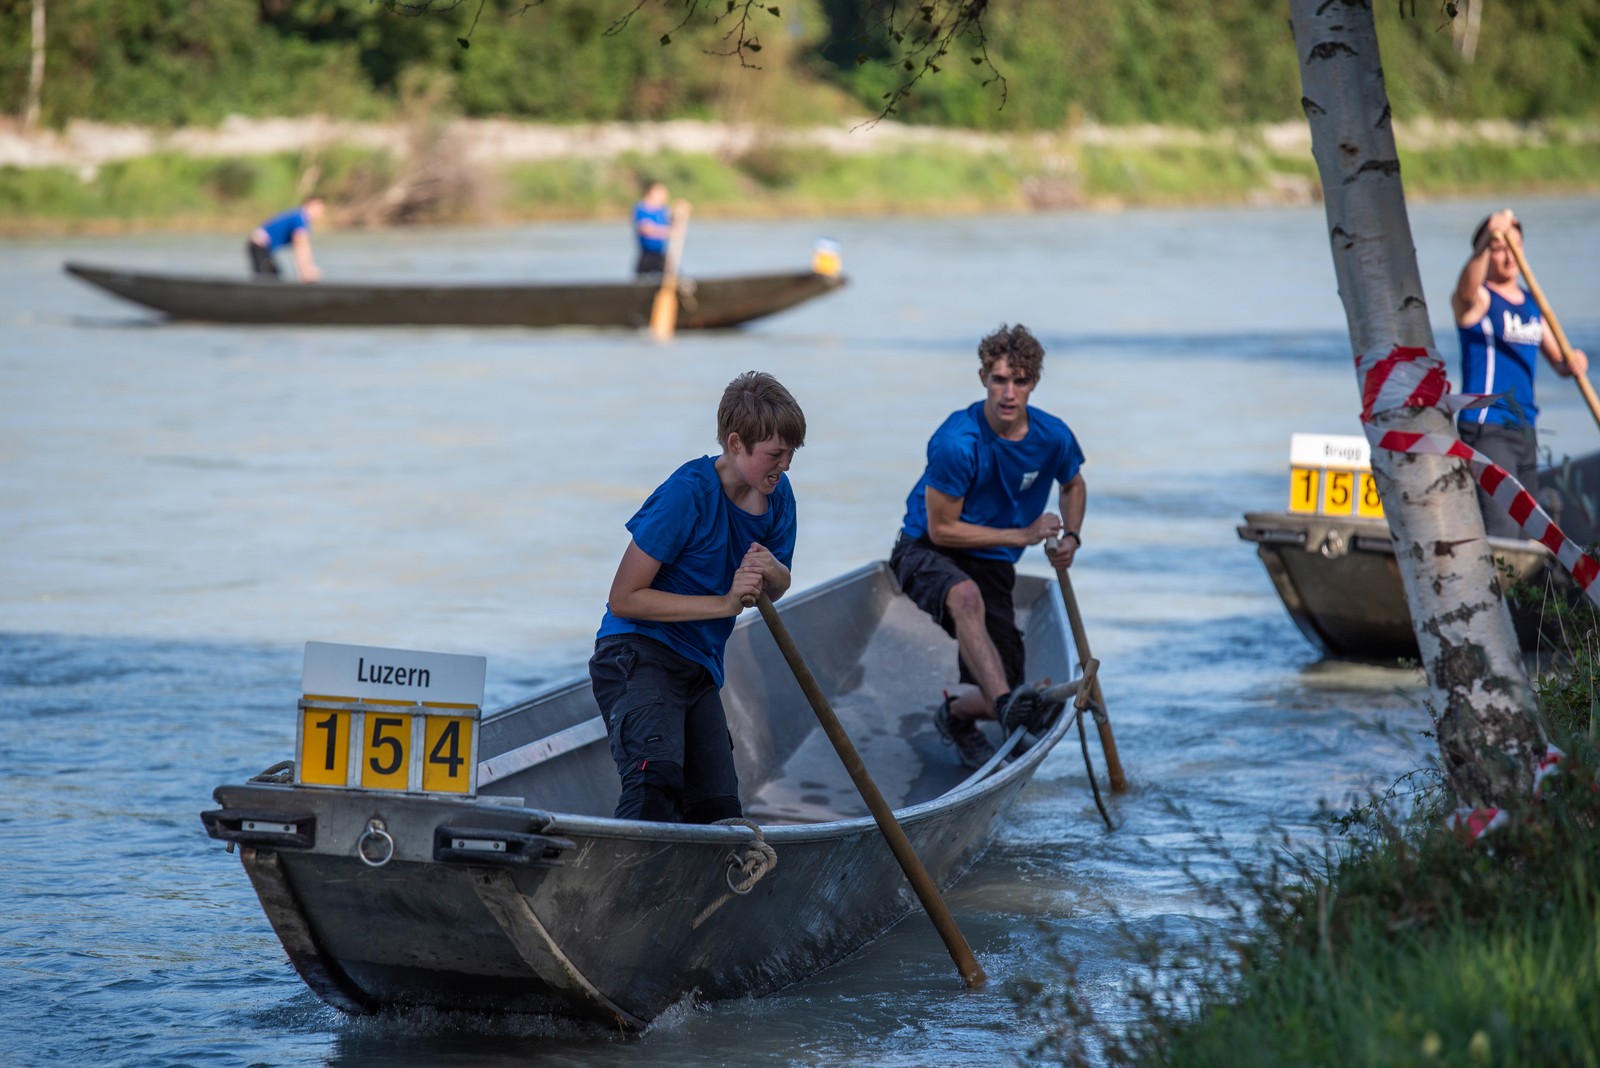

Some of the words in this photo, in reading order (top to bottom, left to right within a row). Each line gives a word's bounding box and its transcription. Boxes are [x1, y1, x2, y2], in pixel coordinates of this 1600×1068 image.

[1325, 444, 1361, 461] Brugg
[357, 657, 431, 688] Luzern
[316, 713, 465, 778] 154
